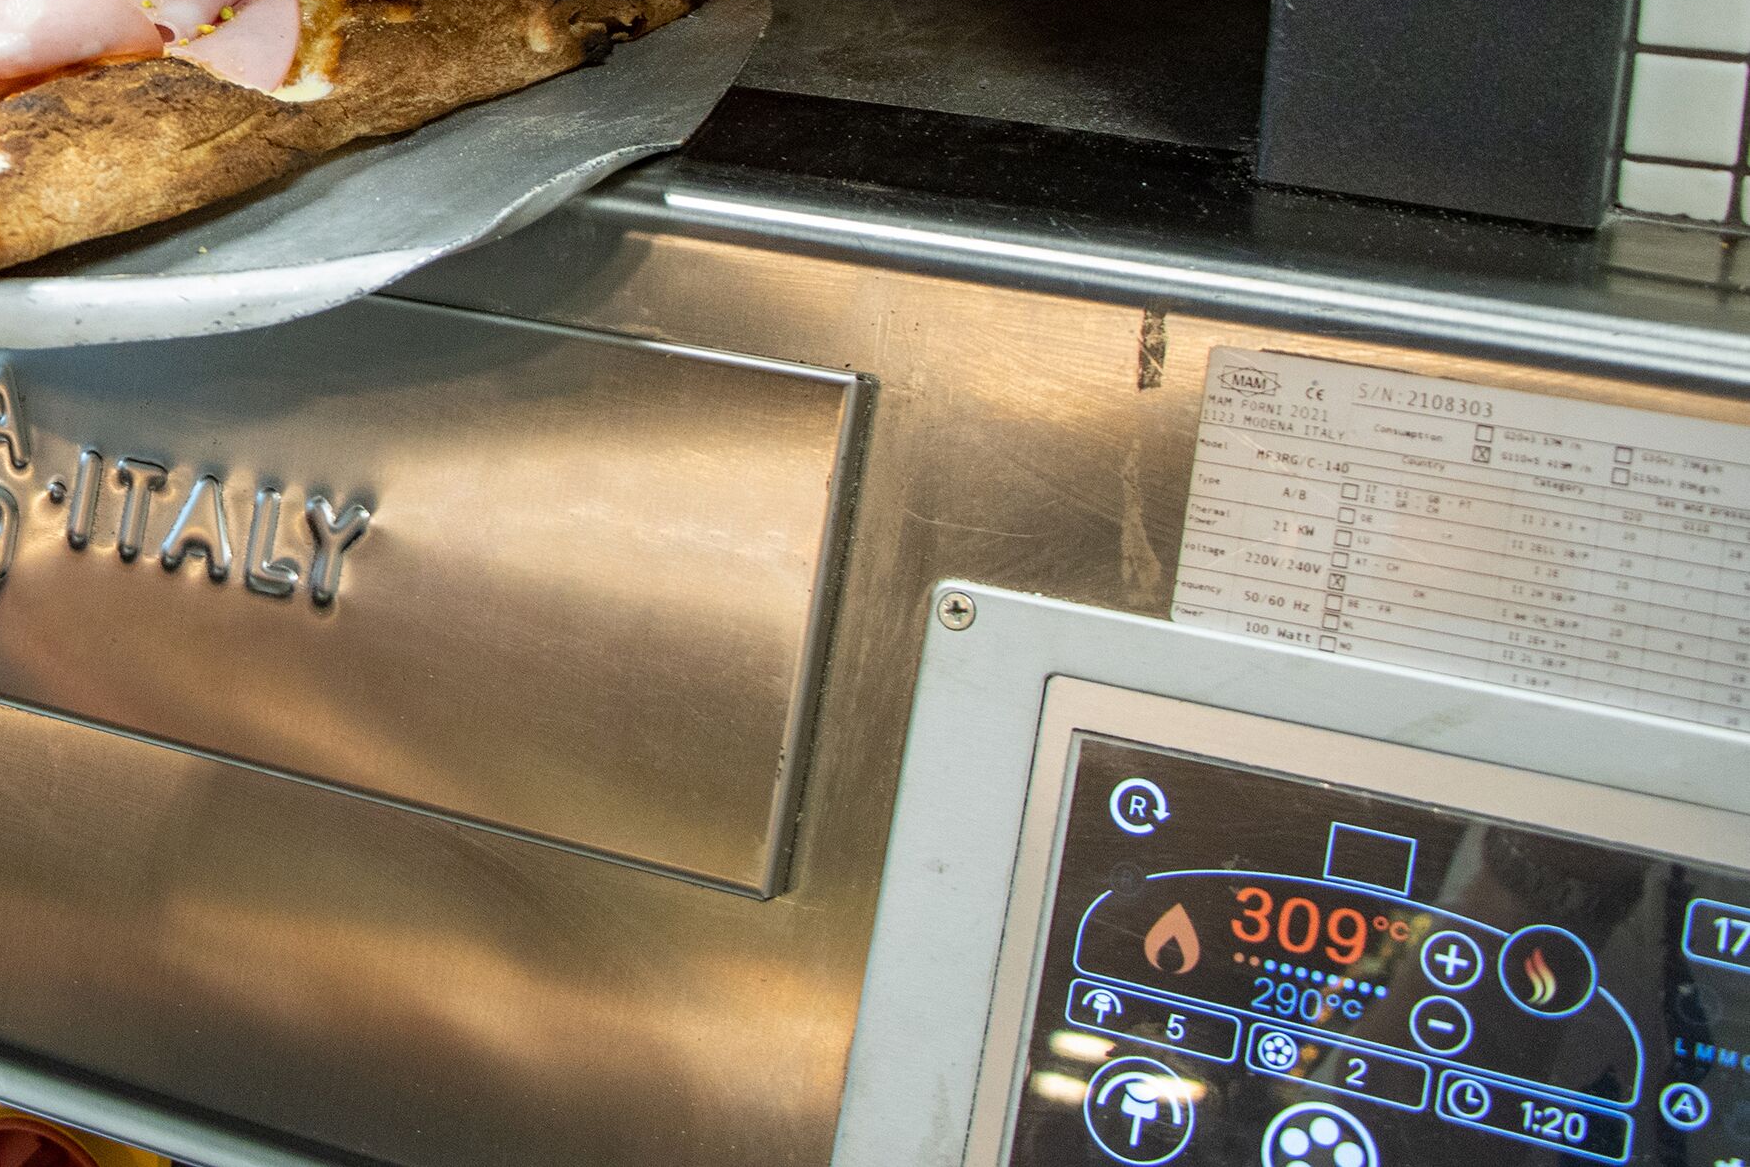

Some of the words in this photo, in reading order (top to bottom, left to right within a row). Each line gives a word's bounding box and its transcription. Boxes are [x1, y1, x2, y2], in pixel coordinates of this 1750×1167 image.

[1233, 374, 1267, 391] MAM
[1207, 394, 1232, 407] MAM
[1241, 399, 1283, 416] FORNI
[1290, 404, 1329, 422] 2021
[1243, 415, 1294, 432] MODENA
[1305, 425, 1346, 441] ITALY
[1373, 423, 1444, 442] Consumption
[1199, 438, 1228, 450] Model
[1402, 455, 1445, 471] Country
[1199, 473, 1221, 485] Type
[1282, 487, 1307, 500] A/B
[1191, 503, 1231, 517] Thermal
[67, 449, 371, 607] ITALY
[1189, 516, 1217, 526] Power
[1273, 520, 1289, 532] 21
[1184, 542, 1225, 556] Voltage
[1245, 552, 1322, 575] 220V/240V
[1244, 591, 1285, 608] 50/60
[1293, 600, 1311, 612] Hz
[1175, 605, 1204, 617] Power
[1245, 621, 1269, 635] 100
[1277, 627, 1312, 643] Watt
[1165, 1013, 1188, 1041] 5
[1345, 1057, 1368, 1087] 2
[1520, 1100, 1589, 1144] 1:20
